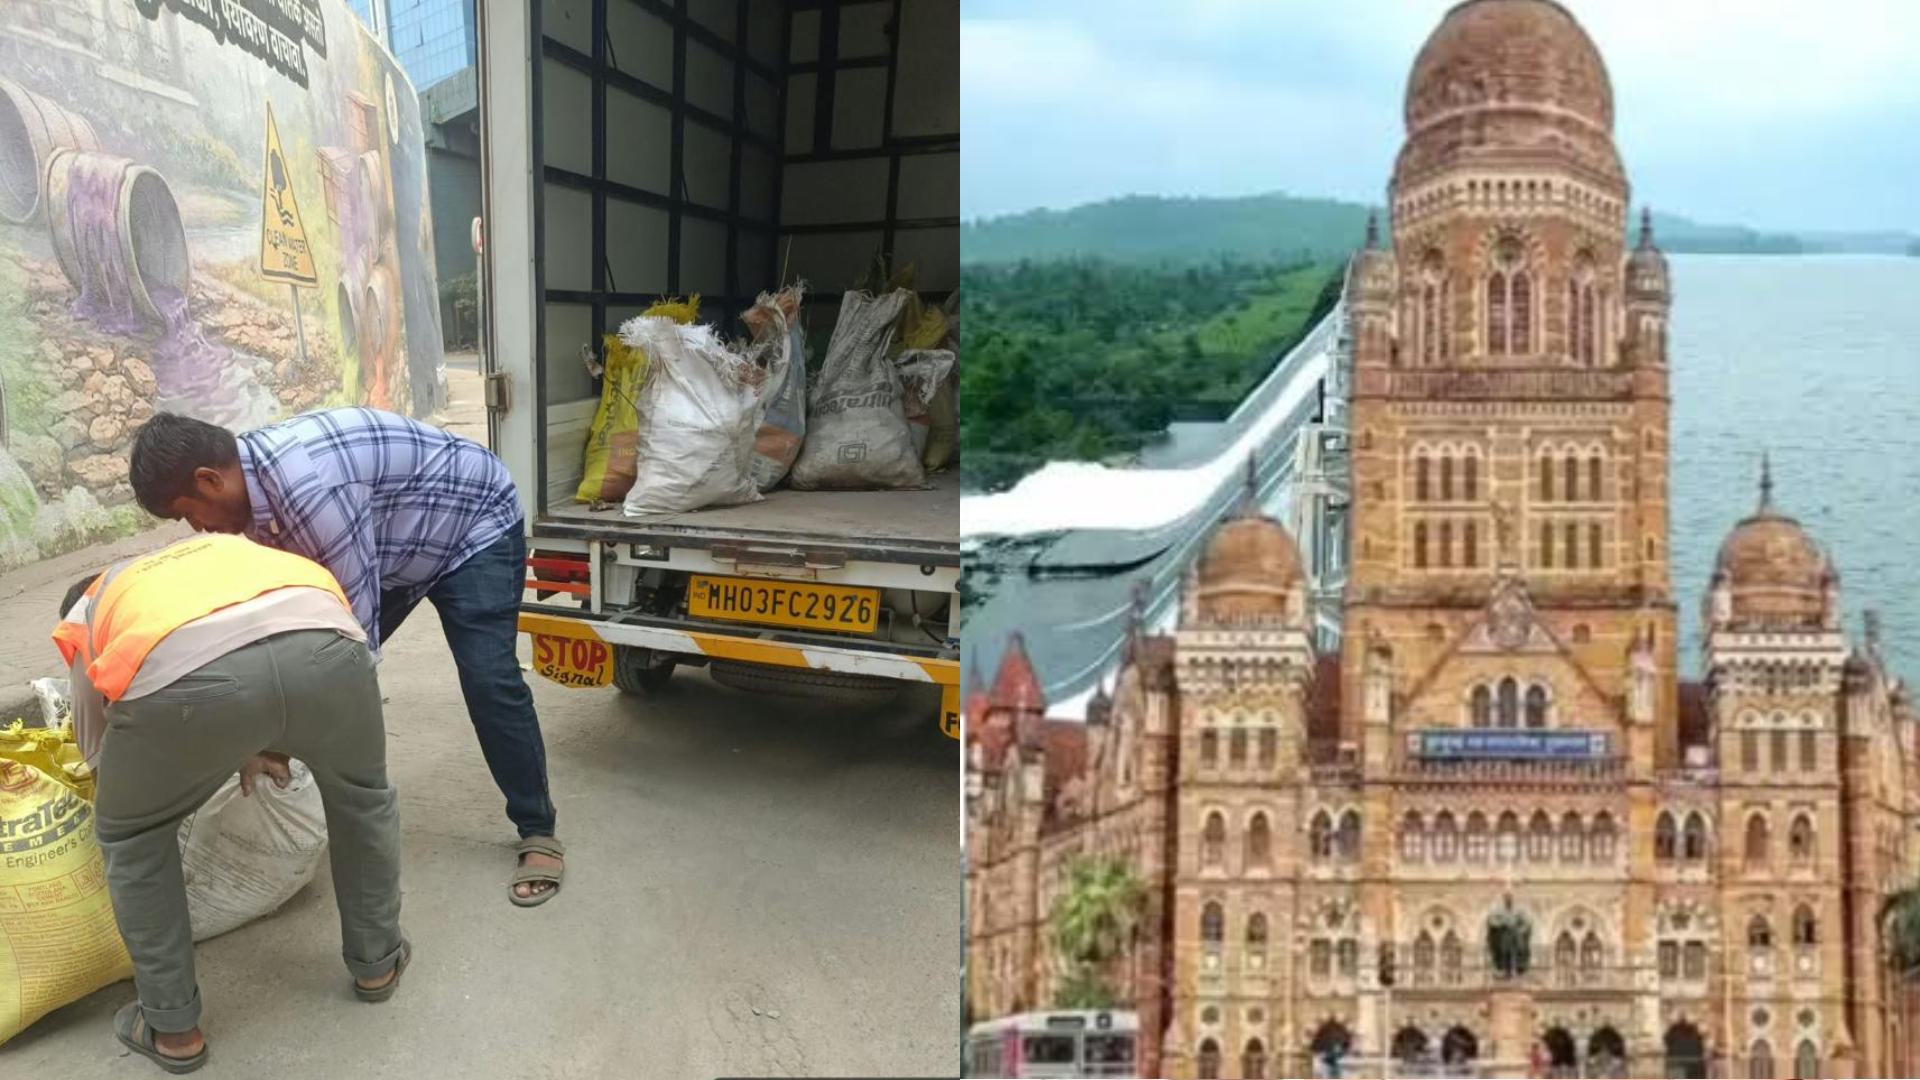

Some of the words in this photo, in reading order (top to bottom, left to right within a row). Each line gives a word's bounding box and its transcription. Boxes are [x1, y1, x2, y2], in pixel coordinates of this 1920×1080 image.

[708, 583, 872, 625] MH03FC2926
[537, 634, 608, 673] STOP
[541, 664, 604, 686] Signal
[945, 711, 960, 733] F
[6, 837, 77, 869] Engineer's
